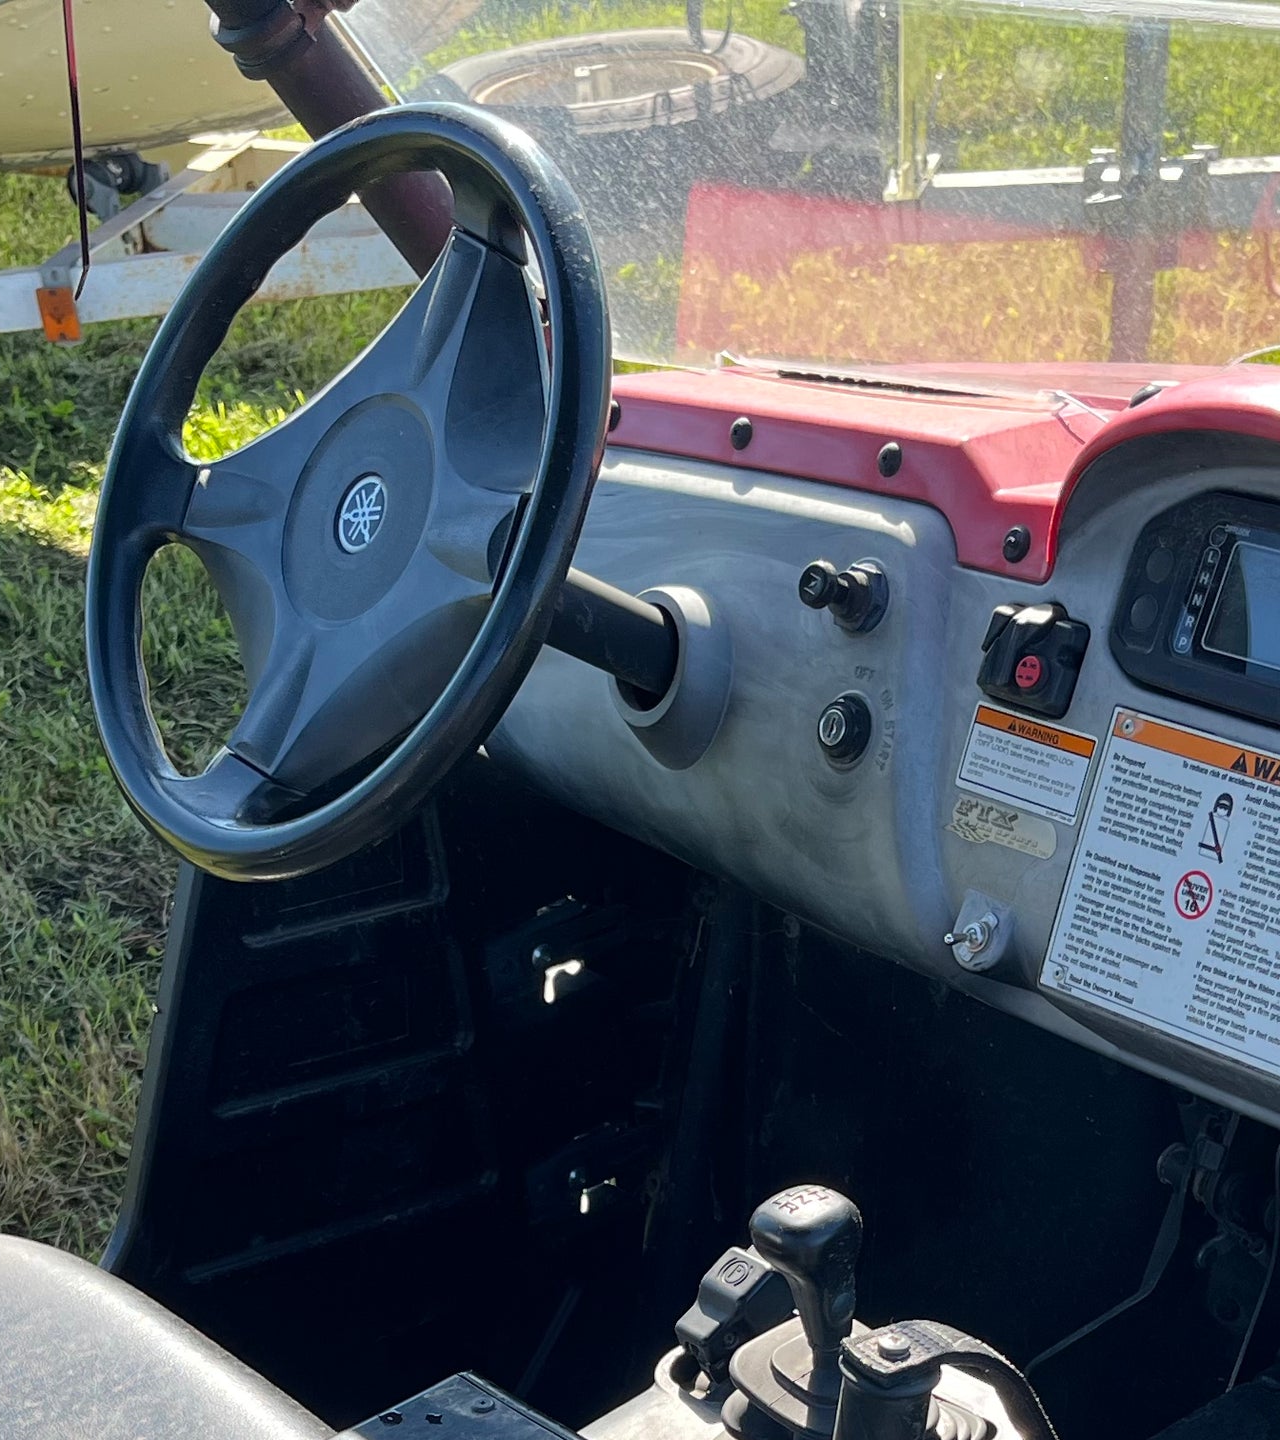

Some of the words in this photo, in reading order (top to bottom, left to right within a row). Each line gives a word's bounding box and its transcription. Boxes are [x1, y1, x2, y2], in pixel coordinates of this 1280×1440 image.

[1207, 550, 1215, 563] L
[1199, 572, 1210, 585] H
[1192, 593, 1203, 607] N
[1185, 615, 1195, 628] R
[1178, 636, 1188, 649] P
[855, 664, 876, 682] OFF
[1017, 723, 1060, 745] WARNING
[876, 720, 896, 772] START
[1120, 754, 1146, 769] Prepared
[1188, 762, 1209, 775] reduce
[1208, 768, 1220, 779] risk
[1227, 774, 1256, 790] accidents
[1255, 783, 1268, 794] and
[1244, 793, 1262, 806] Avoid
[1092, 852, 1117, 866] Qualified
[1117, 860, 1128, 870] and
[1127, 864, 1161, 882] Responsible
[1200, 964, 1212, 974] you
[1212, 966, 1228, 979] think
[1235, 974, 1247, 986] feel
[1246, 979, 1257, 989] the
[1257, 982, 1276, 996] Rhino
[1068, 973, 1083, 985] Read
[1082, 978, 1092, 988] the
[1091, 981, 1114, 996] Owner's
[1113, 989, 1135, 1004] Manual
